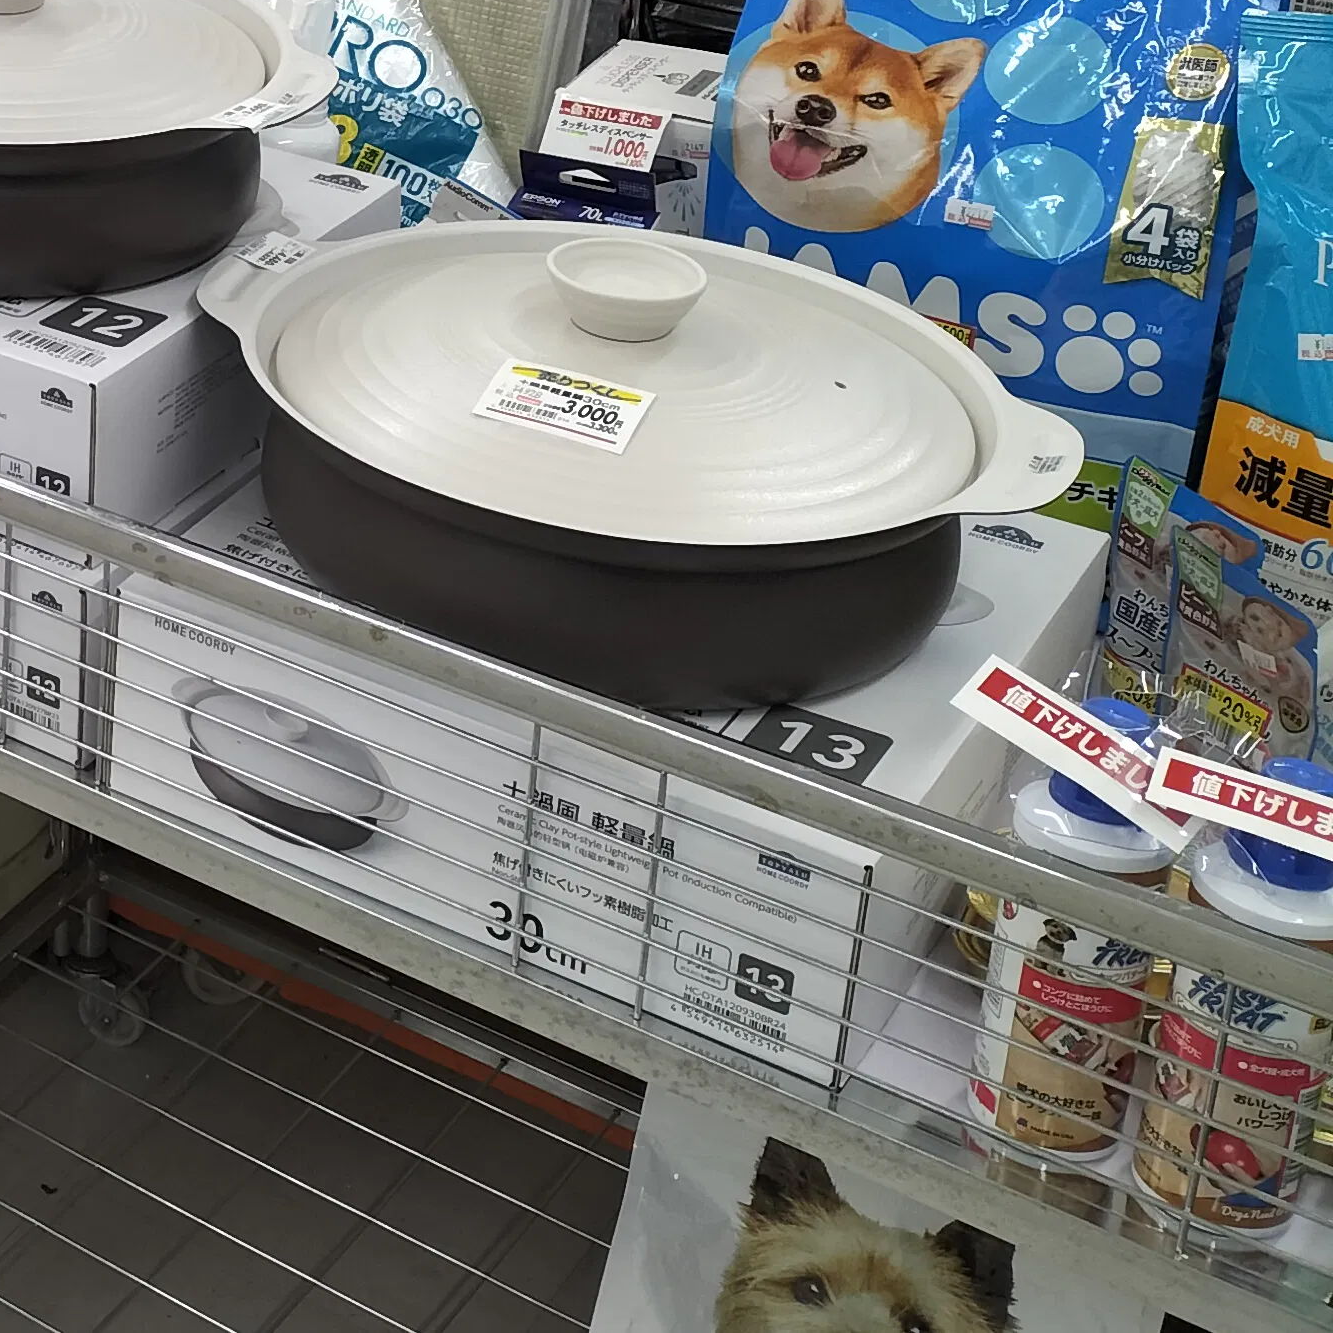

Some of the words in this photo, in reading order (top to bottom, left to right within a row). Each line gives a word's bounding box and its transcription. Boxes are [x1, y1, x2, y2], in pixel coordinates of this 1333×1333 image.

[334, 77, 409, 127] ポリ袋
[570, 103, 653, 128] 値下げしました
[561, 118, 653, 141] タッチレスディスペンサー
[605, 137, 648, 160] 1,000円
[383, 159, 427, 196] 100
[444, 181, 494, 212] AudioComm
[522, 193, 563, 206] EPSON
[578, 206, 603, 221] 70L
[1124, 207, 1169, 256] 4
[1121, 252, 1198, 275] 小分けパック
[65, 304, 146, 340] 12
[1146, 324, 1163, 334] TM
[560, 400, 623, 429] 3,000円
[1245, 415, 1301, 449] 成犬用
[41, 474, 66, 495] 12
[1235, 445, 1333, 527] 減量
[779, 719, 868, 768] 13
[592, 811, 675, 859] 軽量鍋
[540, 816, 560, 832] Clay
[562, 823, 603, 849] Pot-style
[662, 865, 679, 880] Pot
[682, 873, 732, 899] (Induction
[734, 894, 797, 924] Compatible)
[486, 901, 587, 975] 30cm
[696, 943, 712, 960] IH
[746, 967, 787, 1003] 13
